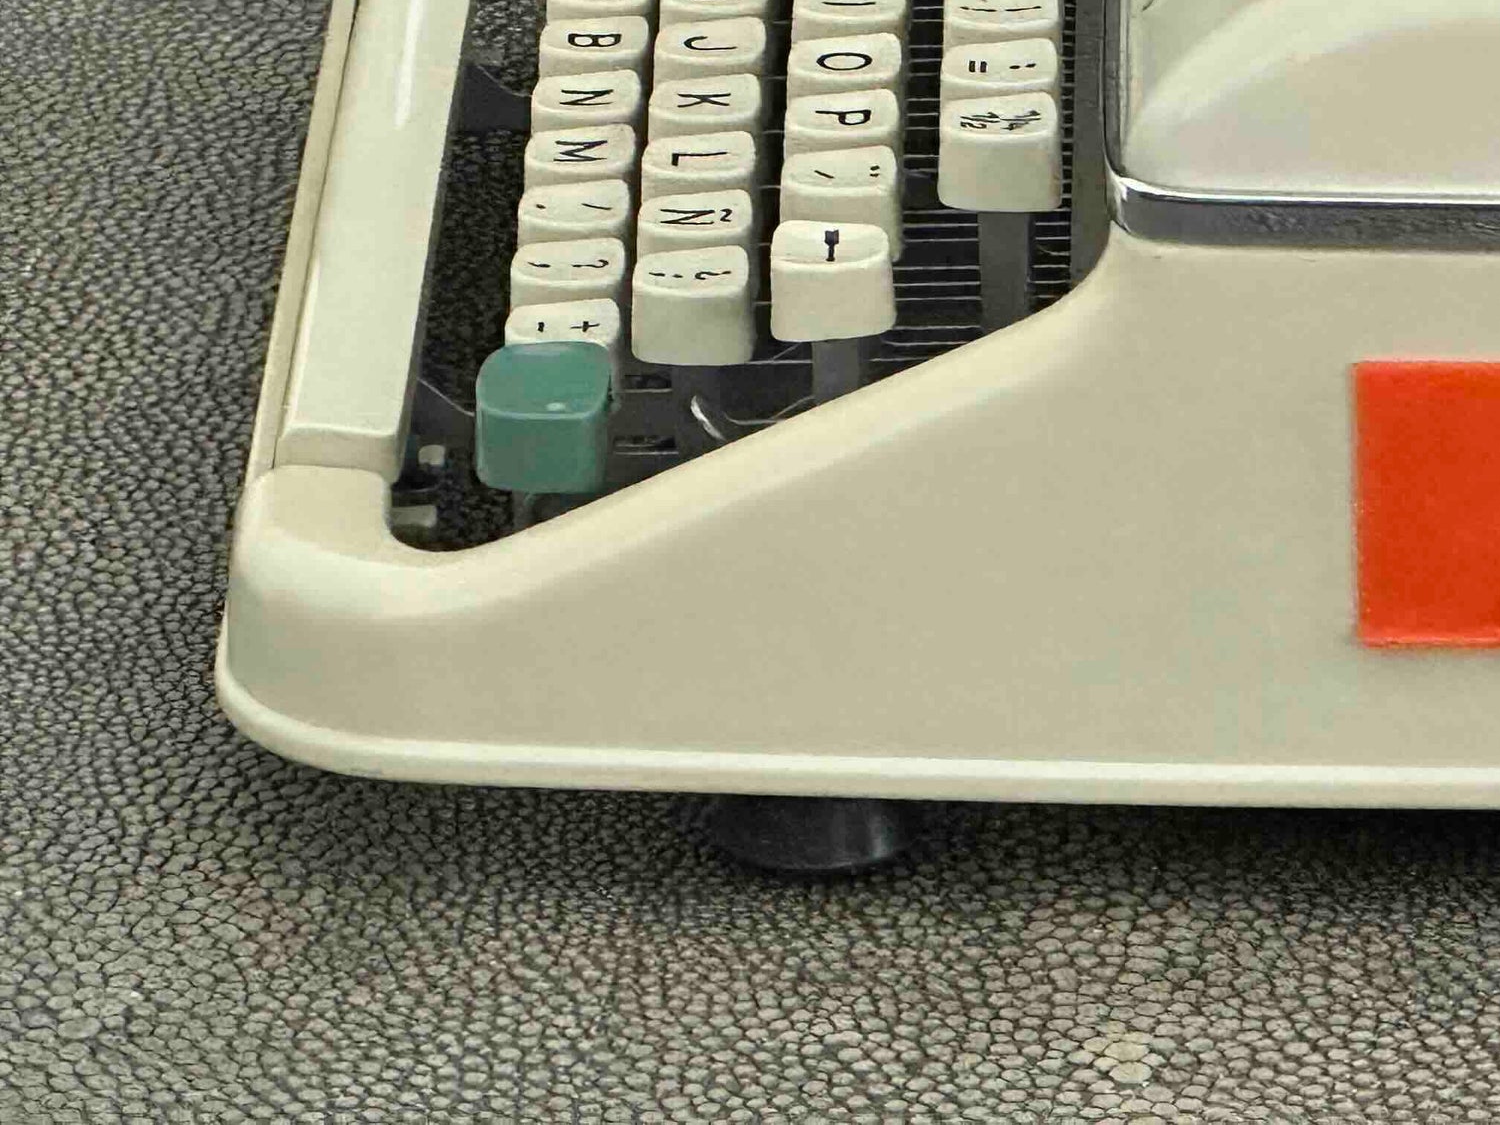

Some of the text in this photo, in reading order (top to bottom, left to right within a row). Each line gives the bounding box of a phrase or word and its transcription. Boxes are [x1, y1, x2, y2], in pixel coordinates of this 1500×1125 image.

[567, 32, 623, 48] B
[683, 35, 738, 51] J
[815, 52, 873, 72] O
[559, 88, 614, 107] N
[676, 92, 732, 109] K
[814, 109, 872, 127] P
[552, 139, 608, 163] M
[670, 151, 729, 167] L
